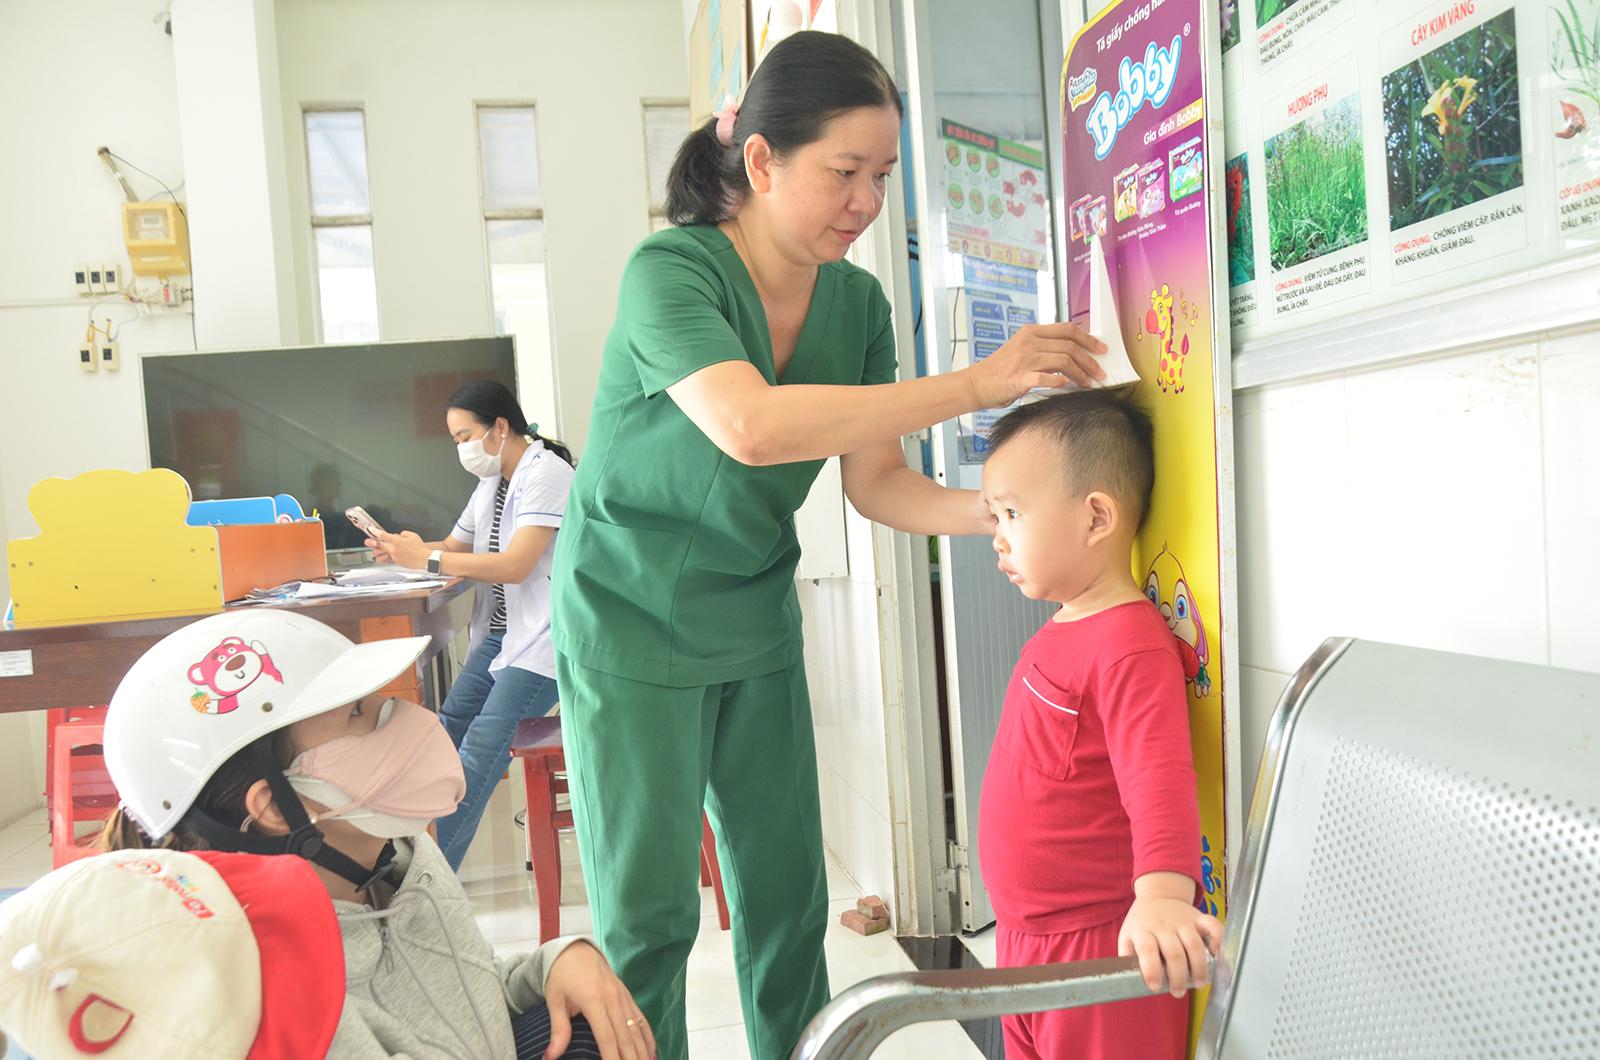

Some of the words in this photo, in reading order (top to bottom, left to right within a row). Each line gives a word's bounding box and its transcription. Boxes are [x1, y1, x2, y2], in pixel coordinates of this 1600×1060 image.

[1096, 36, 1105, 53] Tã
[1106, 22, 1123, 49] giấy
[1124, 3, 1150, 31] chống
[1411, 24, 1428, 46] CÂY
[1429, 13, 1447, 36] KIM
[1447, 0, 1475, 25] VÀNG
[1086, 34, 1182, 161] Bobby
[1288, 91, 1313, 117] HƯƠNG
[1313, 82, 1328, 104] PHỤ
[1143, 130, 1157, 146] Gia
[1158, 118, 1175, 138] đình
[1176, 105, 1202, 128] Bobby
[1393, 240, 1411, 254] CÔNG
[1433, 225, 1457, 240] CHỐNG
[1457, 219, 1474, 232] VIÊM
